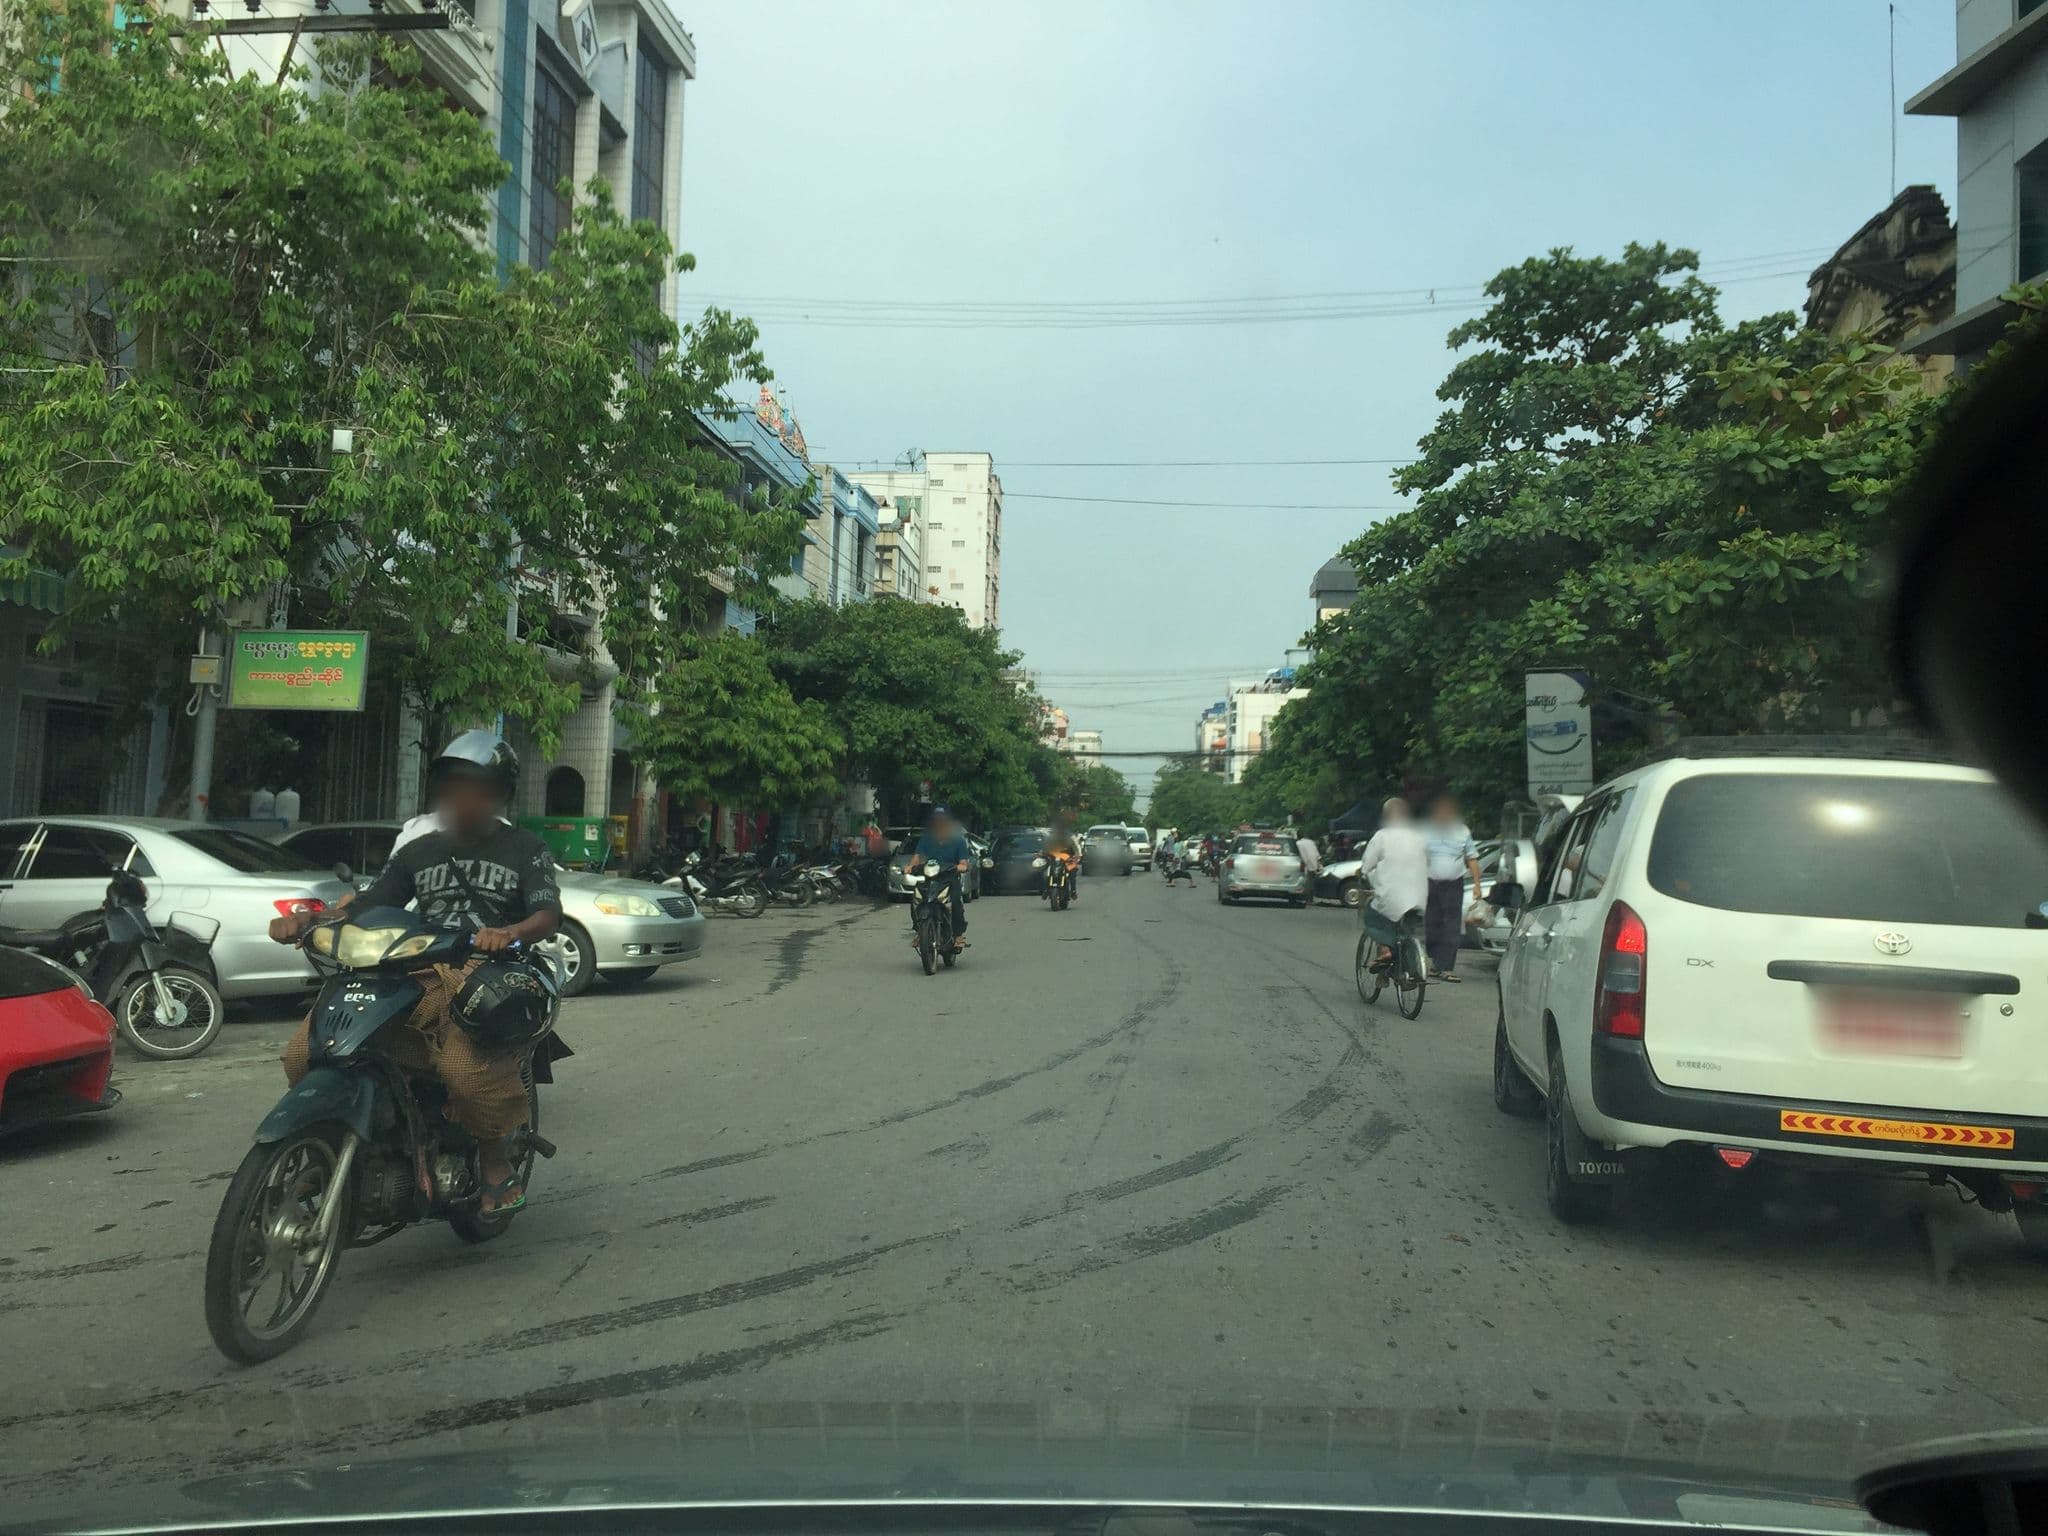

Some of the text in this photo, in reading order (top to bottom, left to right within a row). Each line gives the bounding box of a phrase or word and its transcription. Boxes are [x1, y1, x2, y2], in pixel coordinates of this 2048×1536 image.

[248, 667, 344, 688] ကားပစ္စည်းဆိုင်
[1686, 958, 1715, 969] DX
[1578, 1161, 1625, 1175] TOYOTA
